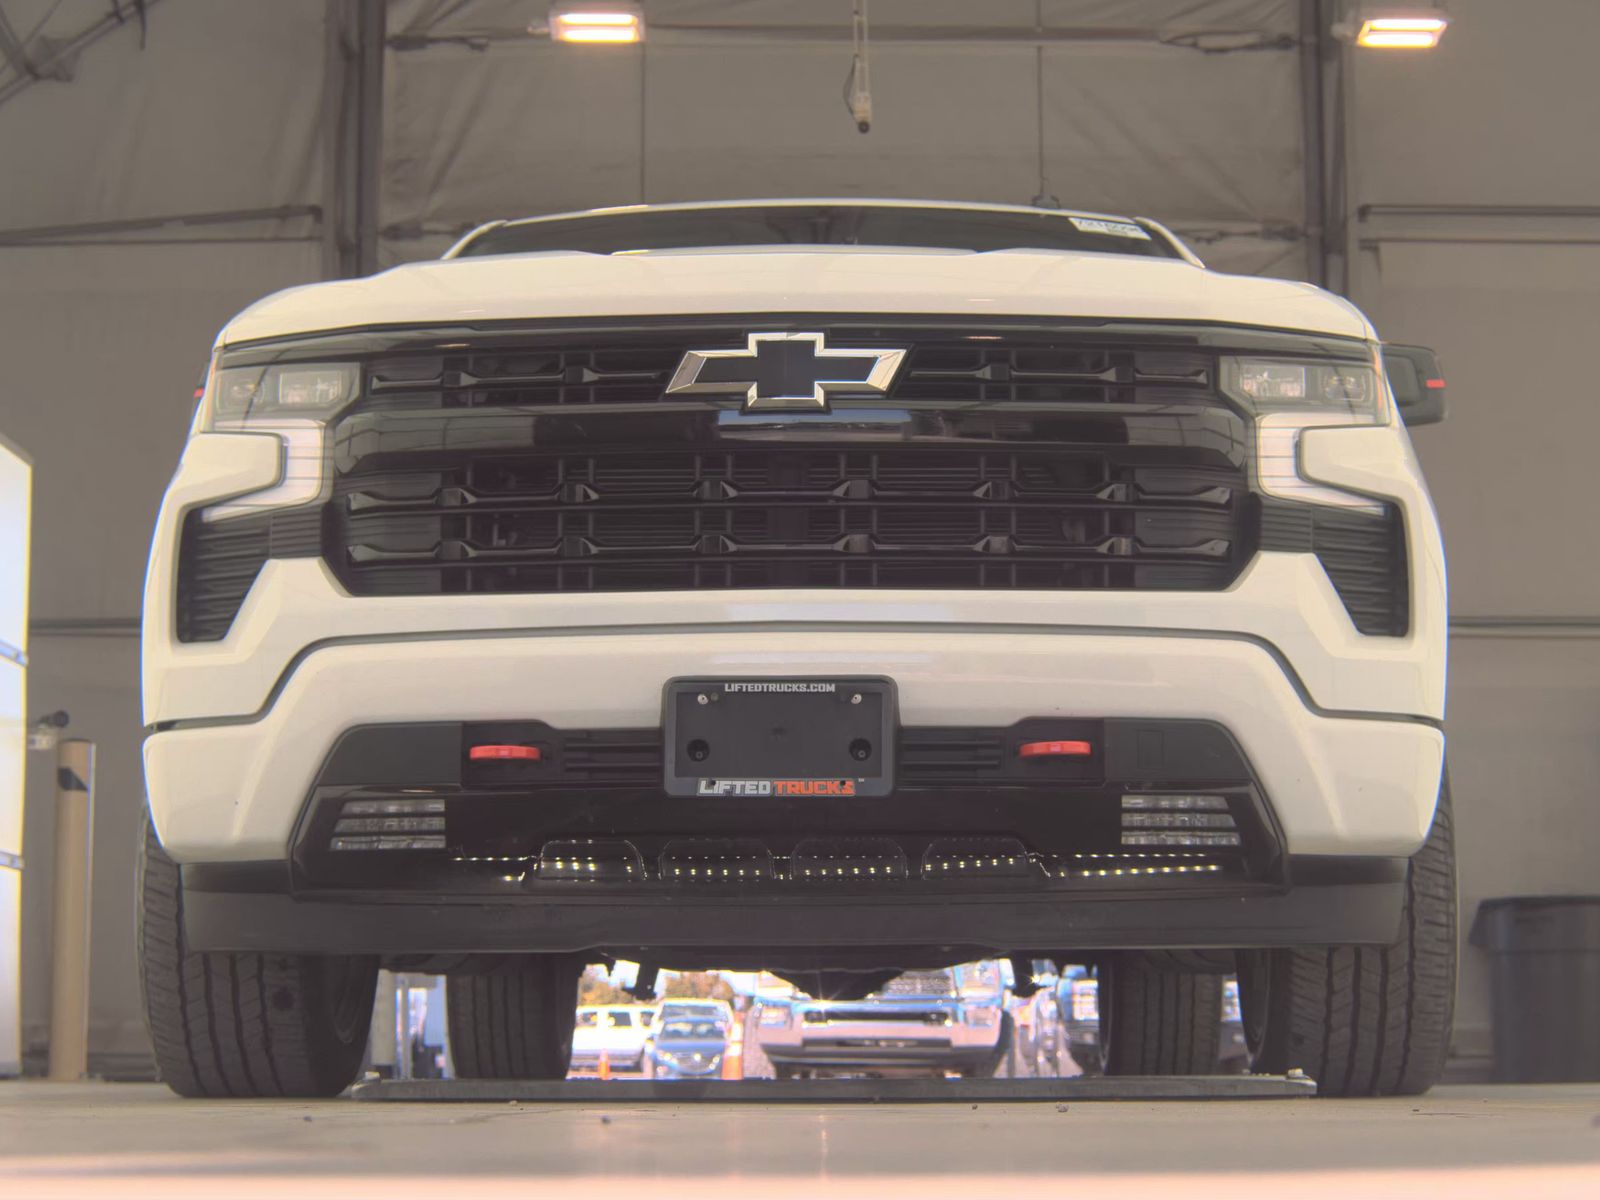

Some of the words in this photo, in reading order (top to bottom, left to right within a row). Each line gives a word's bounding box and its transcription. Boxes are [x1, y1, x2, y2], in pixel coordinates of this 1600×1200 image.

[724, 683, 836, 693] LIFTEDTRUCKS.COM
[699, 779, 771, 795] LIFTED
[774, 780, 855, 796] TRUCKS
